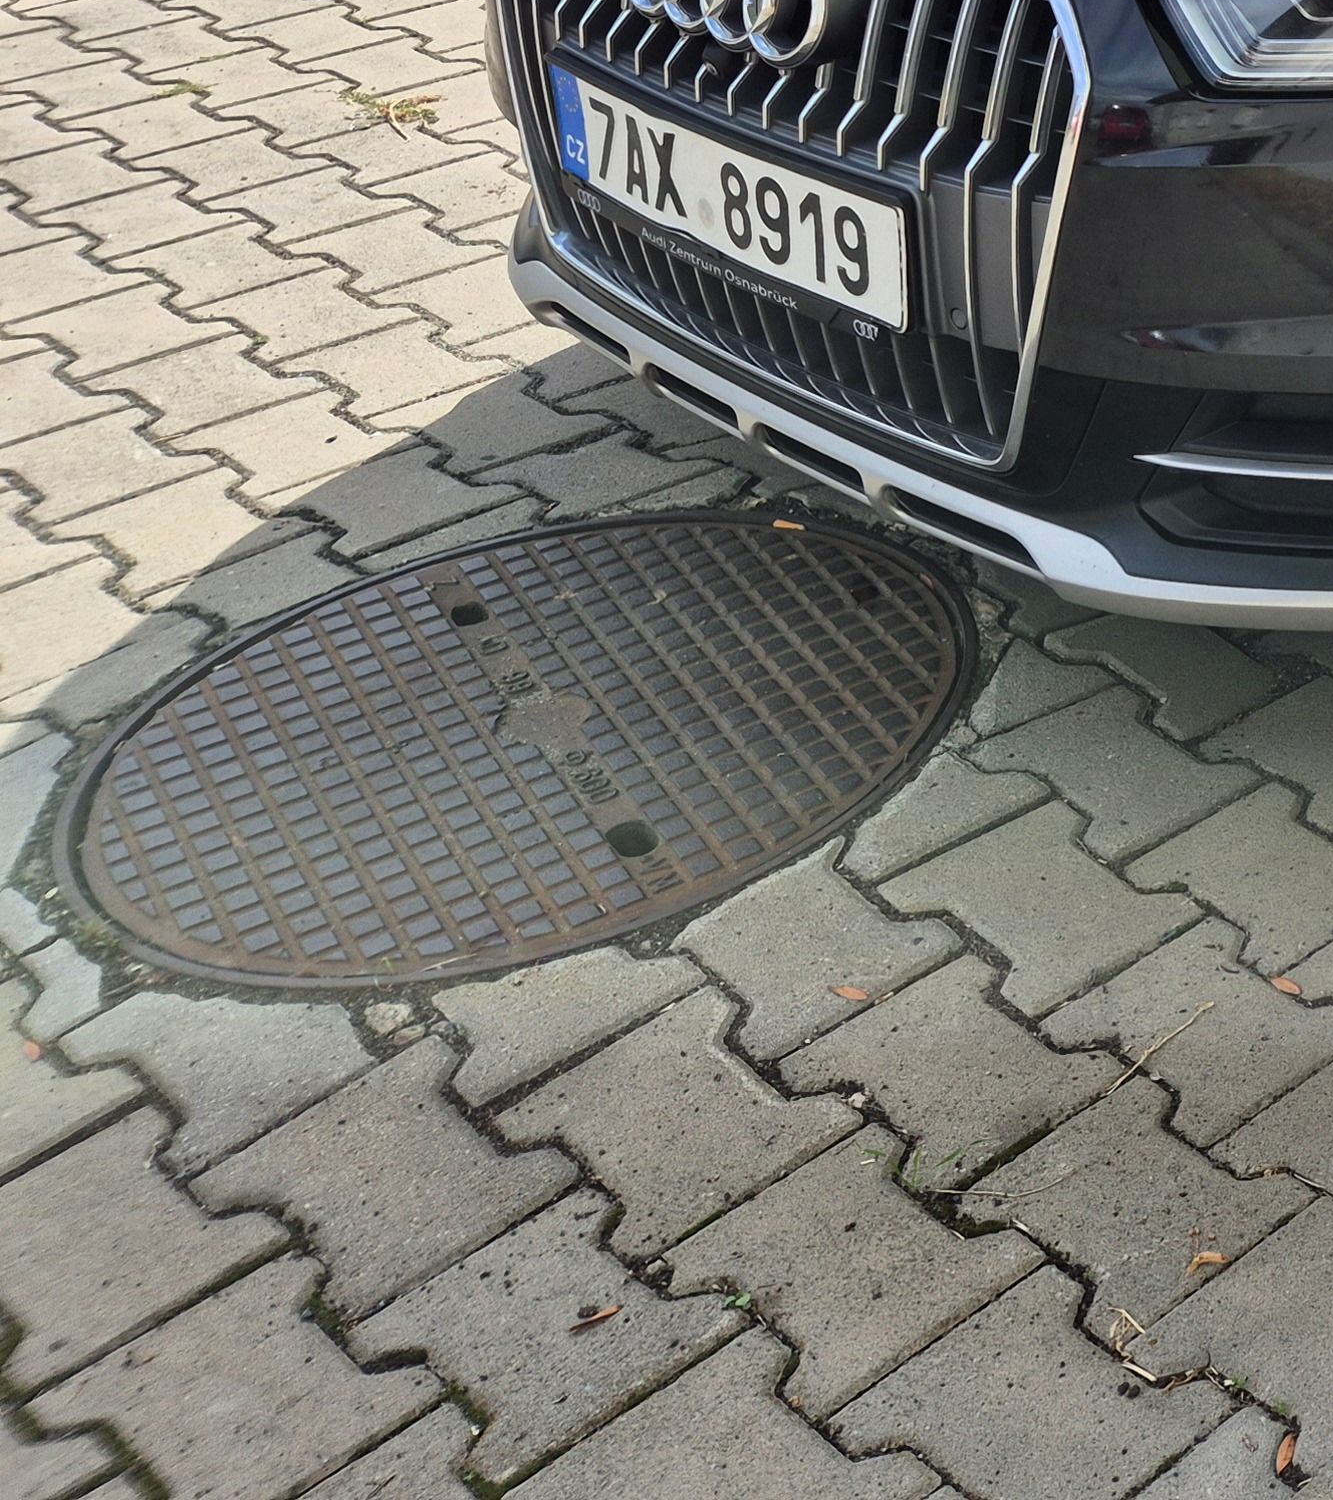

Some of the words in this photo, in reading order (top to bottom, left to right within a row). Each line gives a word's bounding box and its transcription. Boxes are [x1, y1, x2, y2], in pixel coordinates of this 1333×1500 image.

[566, 134, 586, 165] CZ
[589, 97, 687, 219] 7AX
[720, 162, 870, 297] 8919
[641, 227, 667, 249] Audi
[669, 240, 722, 277] Zentrum
[724, 268, 798, 310] Osnabrück
